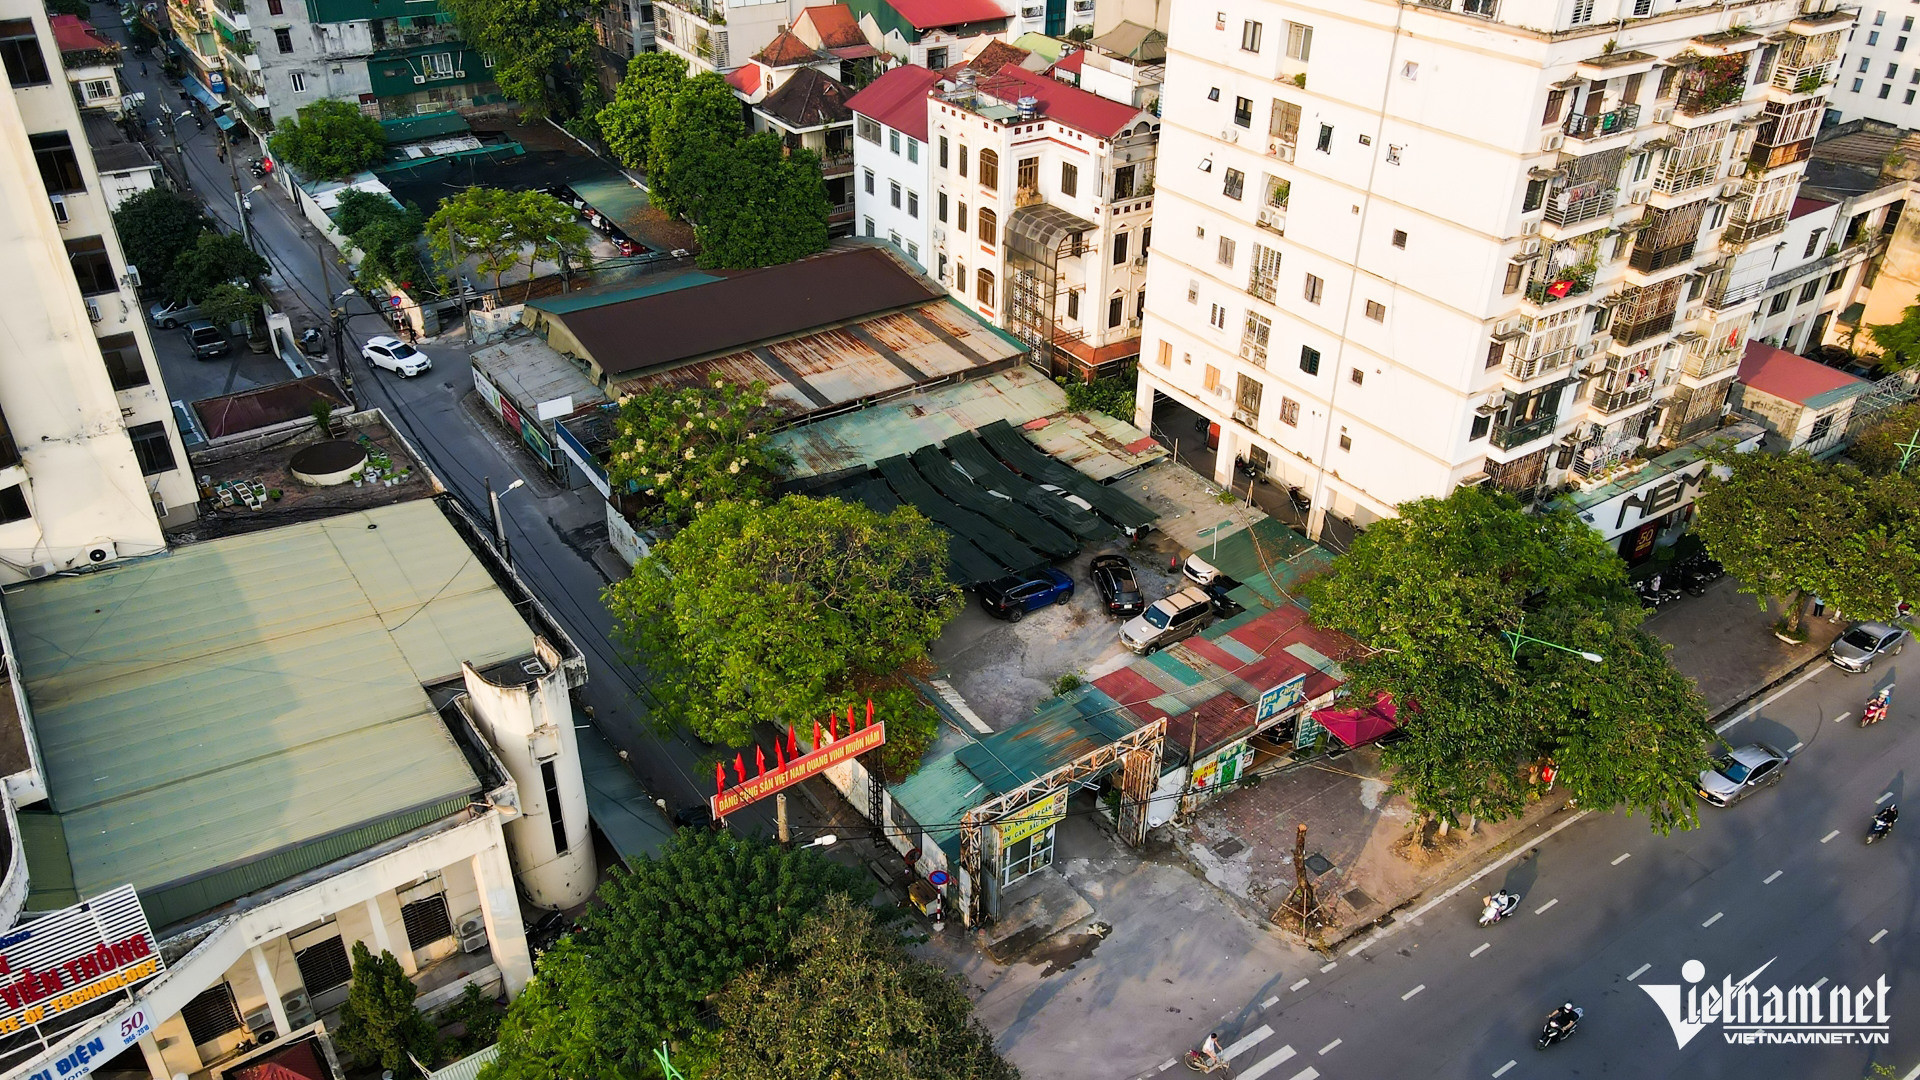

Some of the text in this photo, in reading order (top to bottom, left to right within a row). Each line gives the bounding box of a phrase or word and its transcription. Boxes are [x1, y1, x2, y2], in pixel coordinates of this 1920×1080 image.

[719, 794, 739, 812] ĐẢNG
[760, 777, 774, 793] SẢN
[775, 771, 789, 786] VIỆT
[790, 764, 806, 780] NAM
[807, 753, 828, 772] QUANG
[829, 746, 845, 762] VINH
[845, 737, 864, 755] MUÔN
[865, 731, 880, 747] NĂM
[63, 934, 151, 984] THÔNG
[23, 1005, 45, 1024] OF
[50, 959, 158, 1013] TECHNOLOGY
[121, 1011, 144, 1037] 50
[55, 1037, 104, 1076] ĐIỆN
